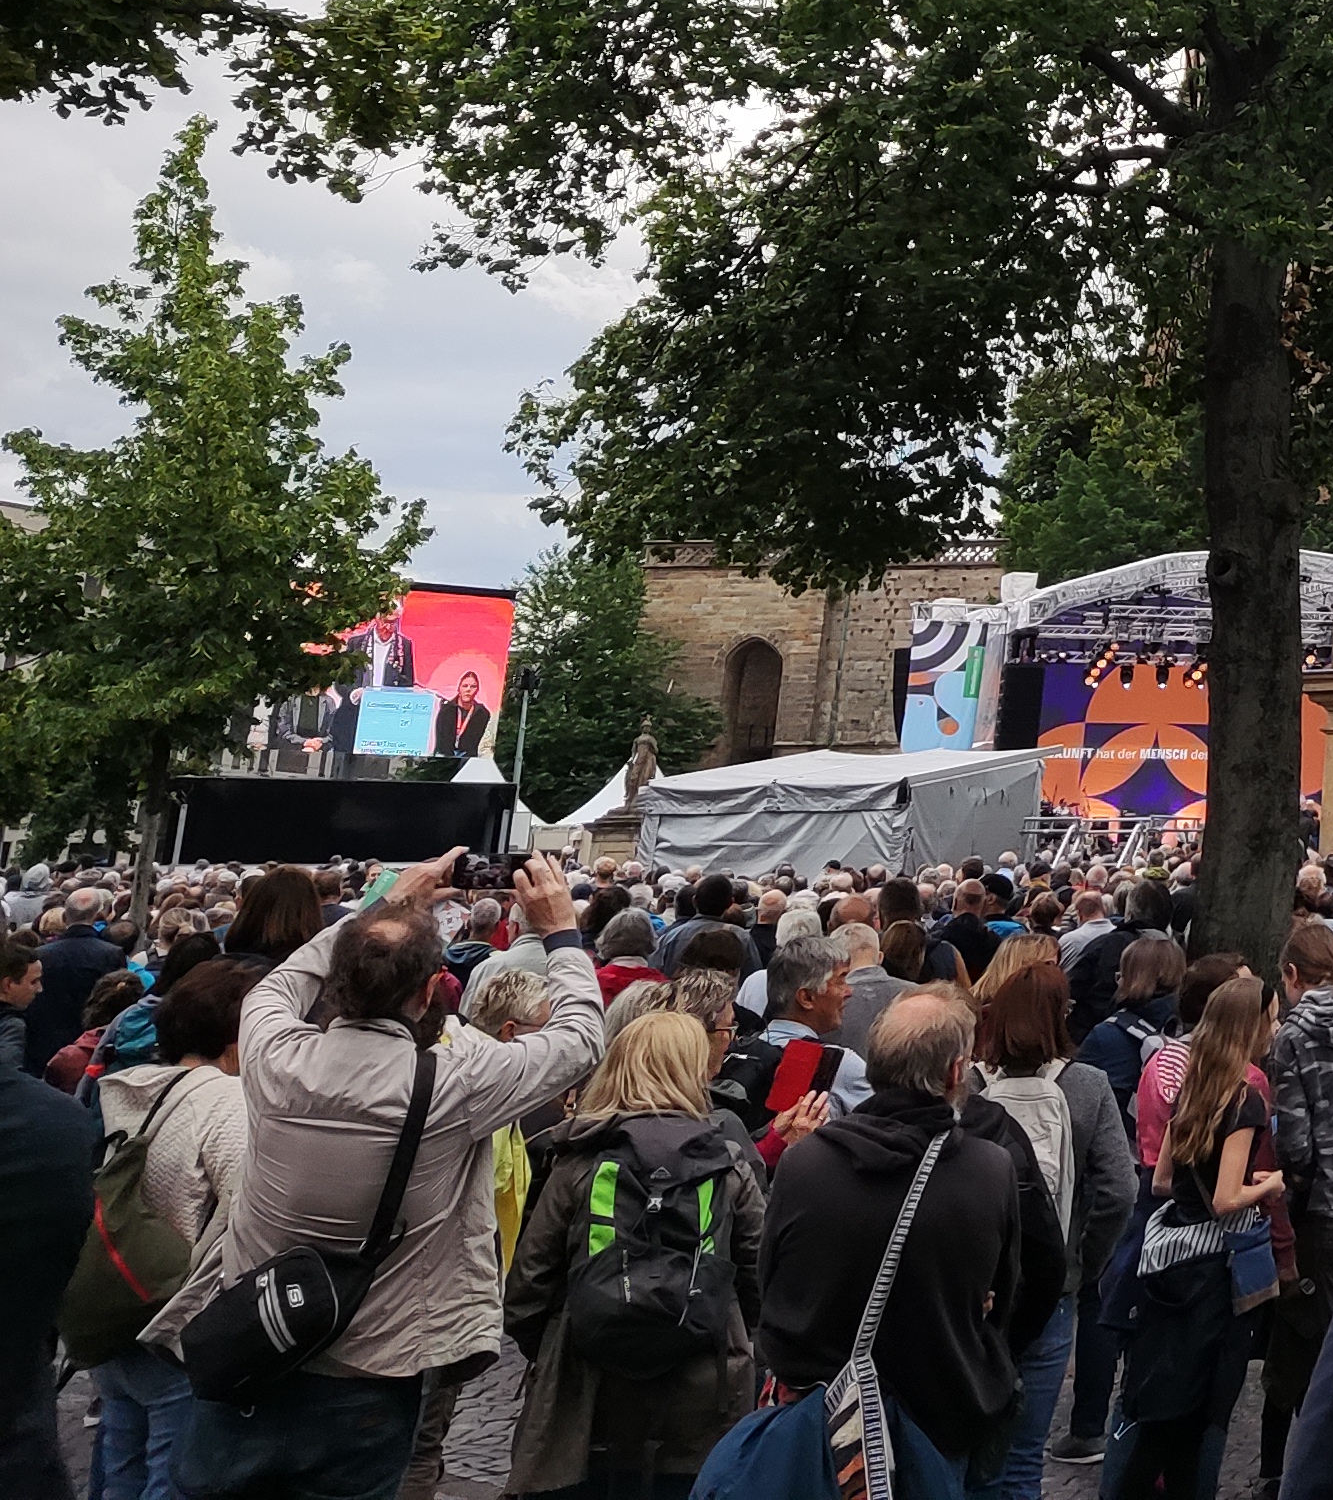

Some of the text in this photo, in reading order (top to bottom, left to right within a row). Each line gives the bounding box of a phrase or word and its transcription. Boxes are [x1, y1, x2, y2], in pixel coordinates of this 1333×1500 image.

[1096, 748, 1114, 759] hat
[1118, 749, 1136, 760] der
[1140, 748, 1189, 760] MENSCH
